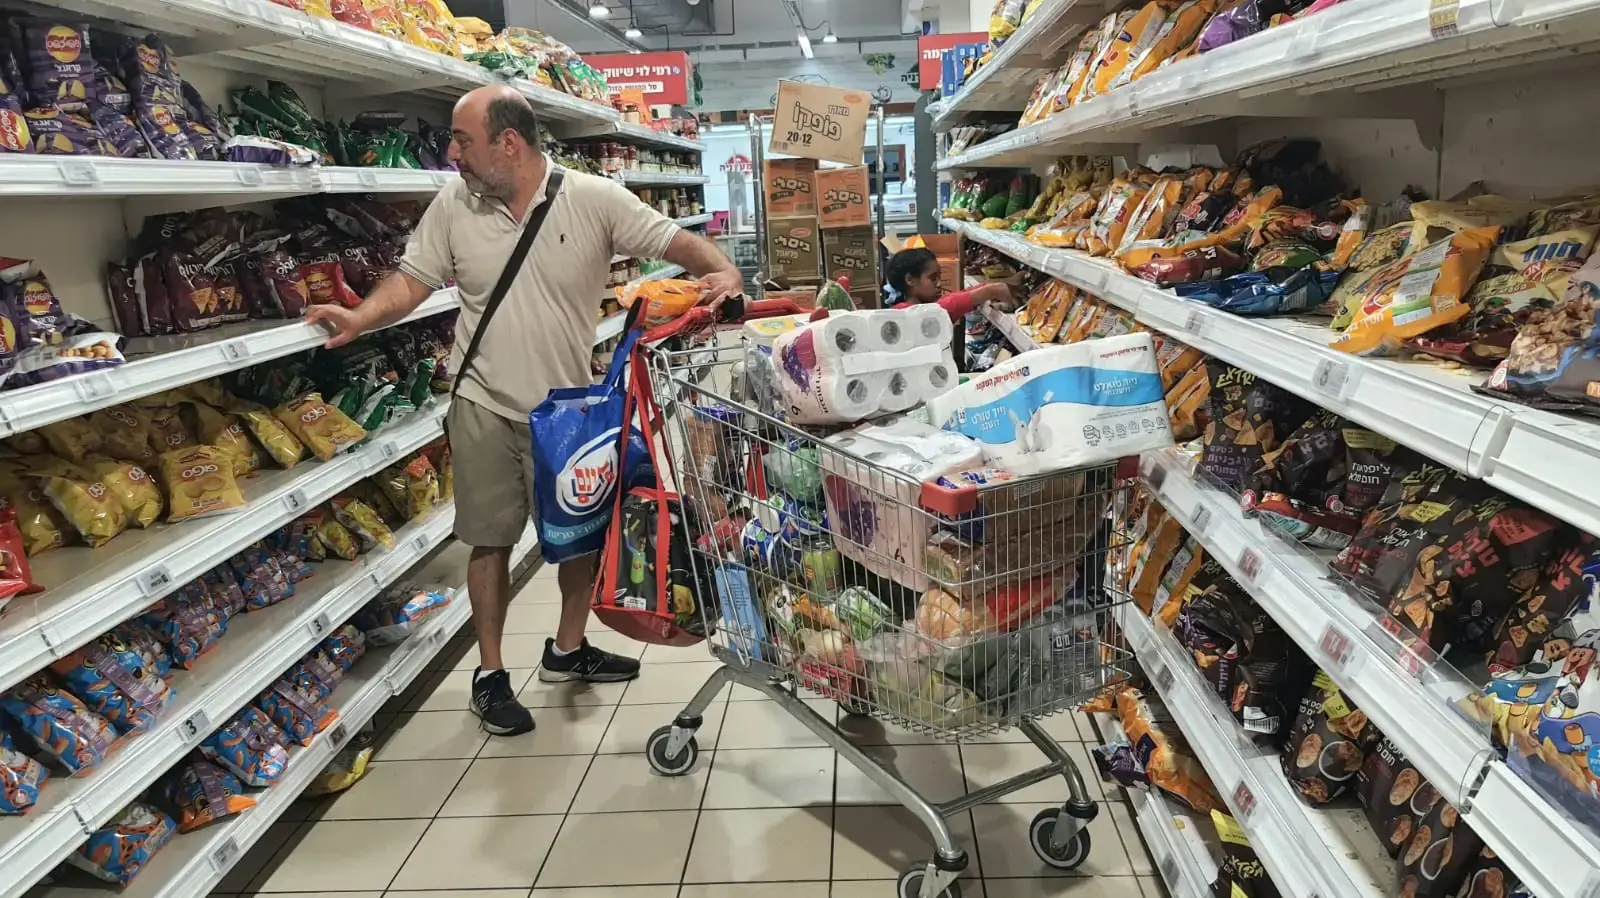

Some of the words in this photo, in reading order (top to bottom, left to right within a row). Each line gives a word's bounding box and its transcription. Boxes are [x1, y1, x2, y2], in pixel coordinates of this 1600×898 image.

[603, 66, 634, 78] שיווק
[635, 64, 650, 77] לוי
[652, 65, 672, 76] רמי
[772, 177, 810, 193] ביסלי
[824, 189, 863, 204] ביסלי
[774, 235, 811, 252] ביסלי
[1215, 366, 1256, 388] EXTR
[186, 720, 196, 735] 3
